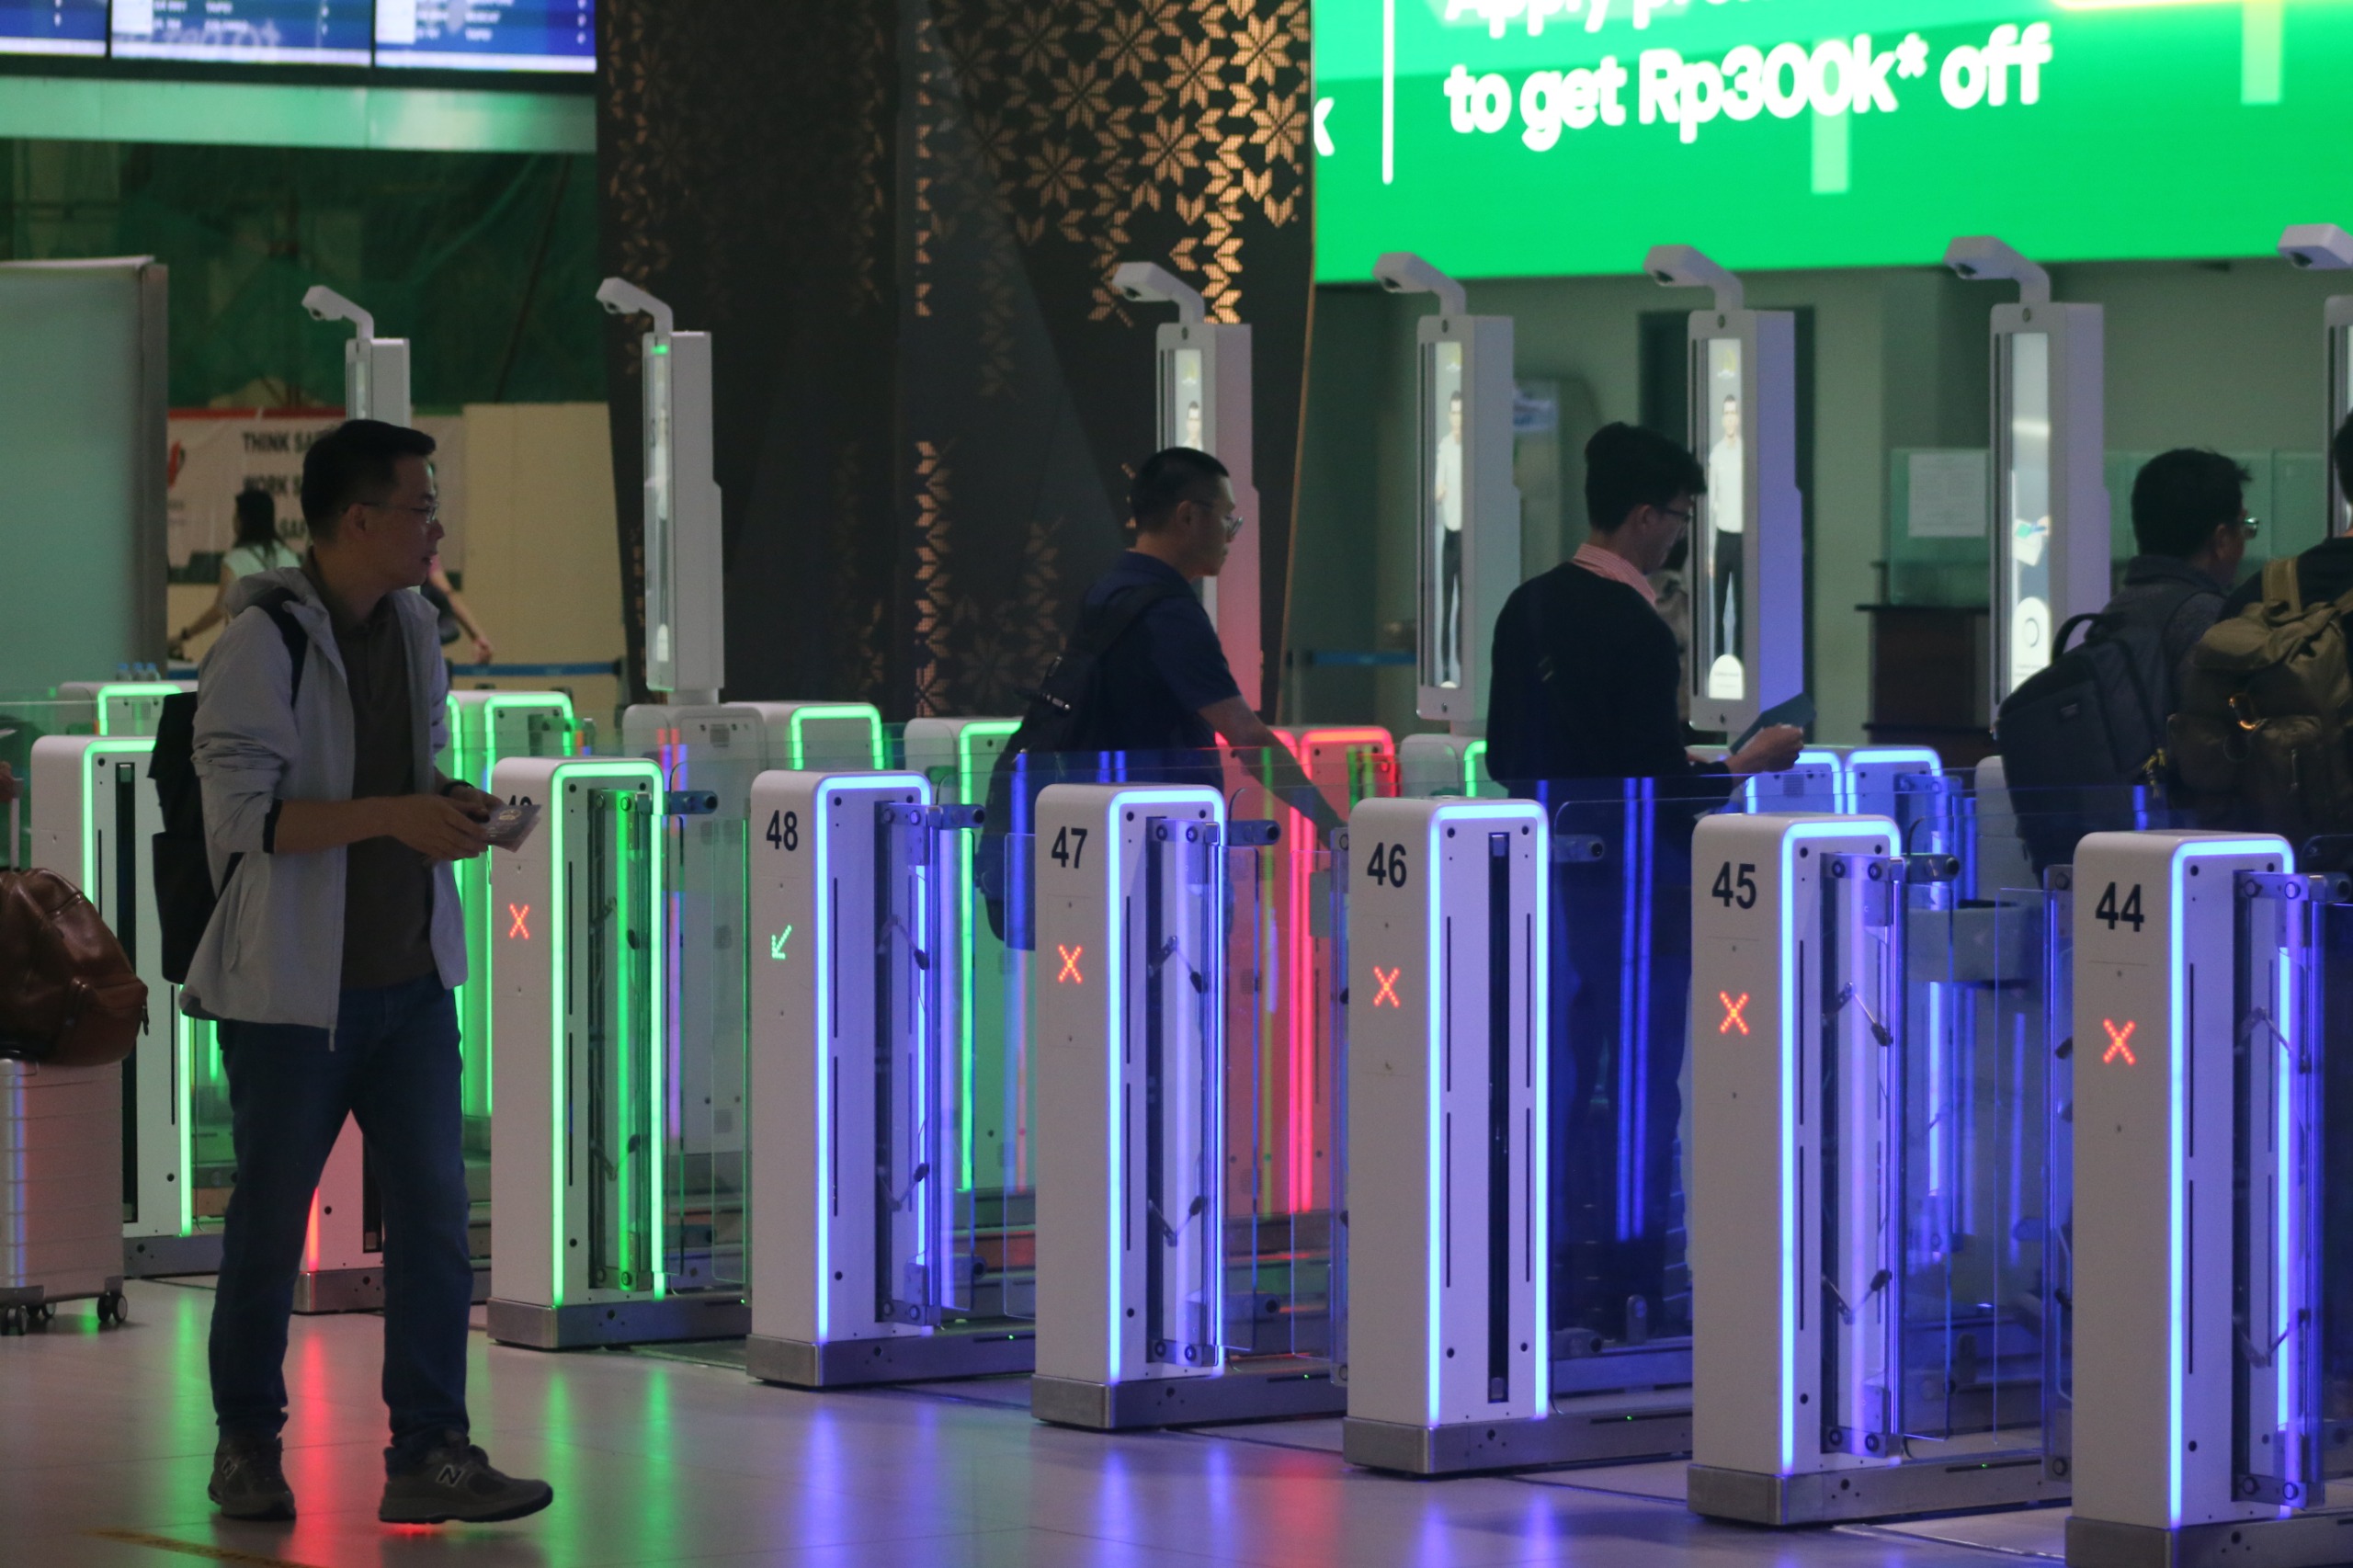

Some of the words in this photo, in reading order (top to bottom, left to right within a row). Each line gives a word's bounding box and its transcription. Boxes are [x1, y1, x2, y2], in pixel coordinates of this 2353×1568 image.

[1444, 64, 1513, 133] to
[1520, 56, 1628, 152] get
[1939, 23, 2053, 110] off
[766, 809, 799, 852] 48
[1051, 825, 1088, 869] 47
[1366, 842, 1408, 889] 46
[1711, 861, 1757, 910] 45
[2095, 881, 2145, 933] 44
